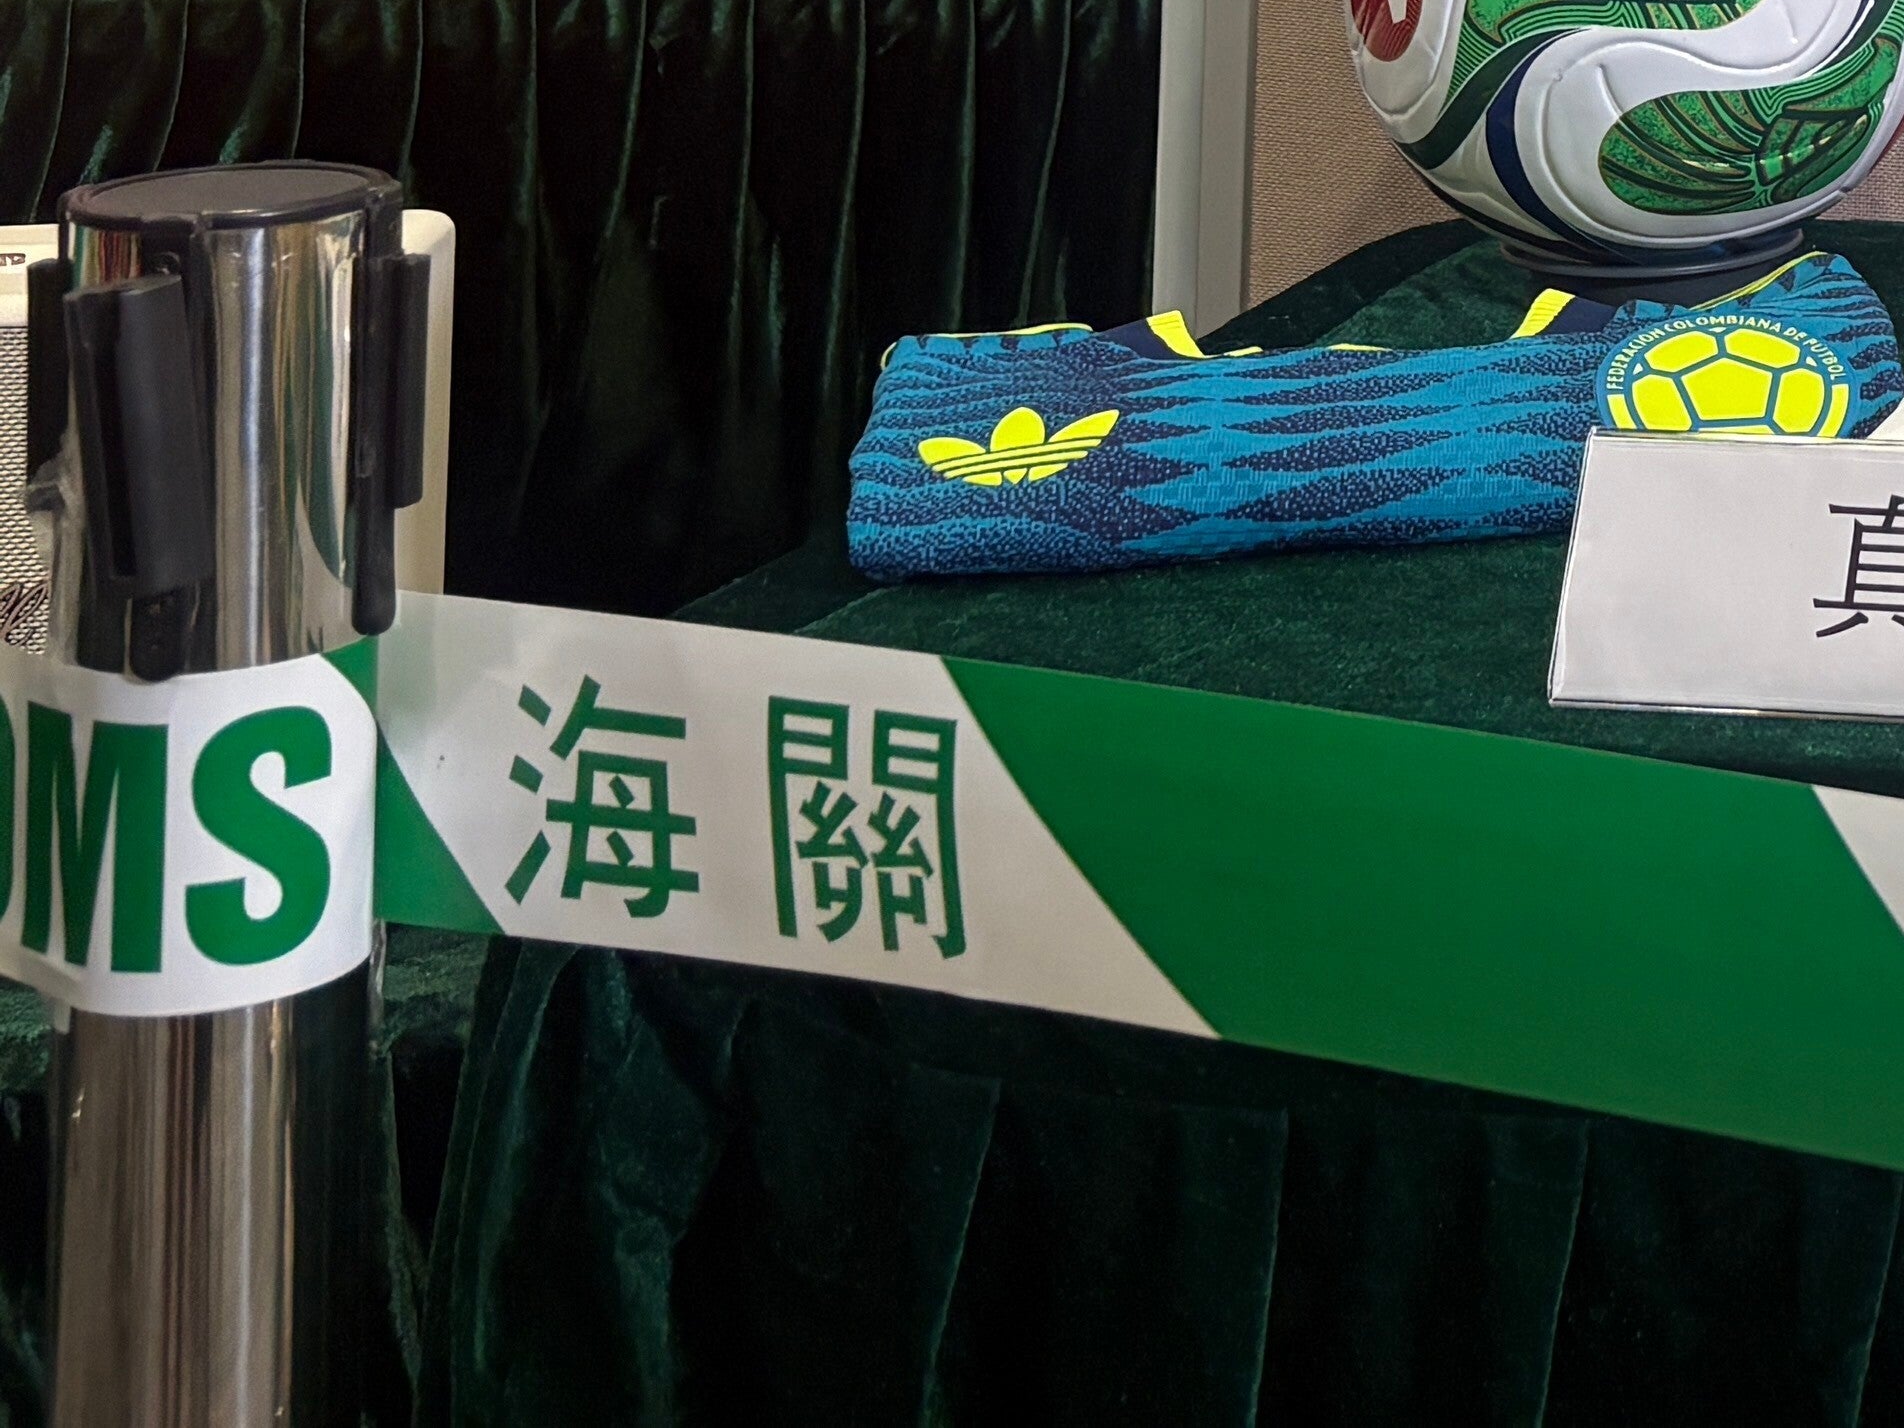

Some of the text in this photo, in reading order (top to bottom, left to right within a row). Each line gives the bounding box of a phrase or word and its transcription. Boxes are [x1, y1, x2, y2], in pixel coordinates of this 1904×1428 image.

[1663, 314, 1782, 336] COLOMBIANA
[1782, 326, 1808, 343] DE
[0, 700, 335, 974] MS
[504, 674, 970, 960] 海關
